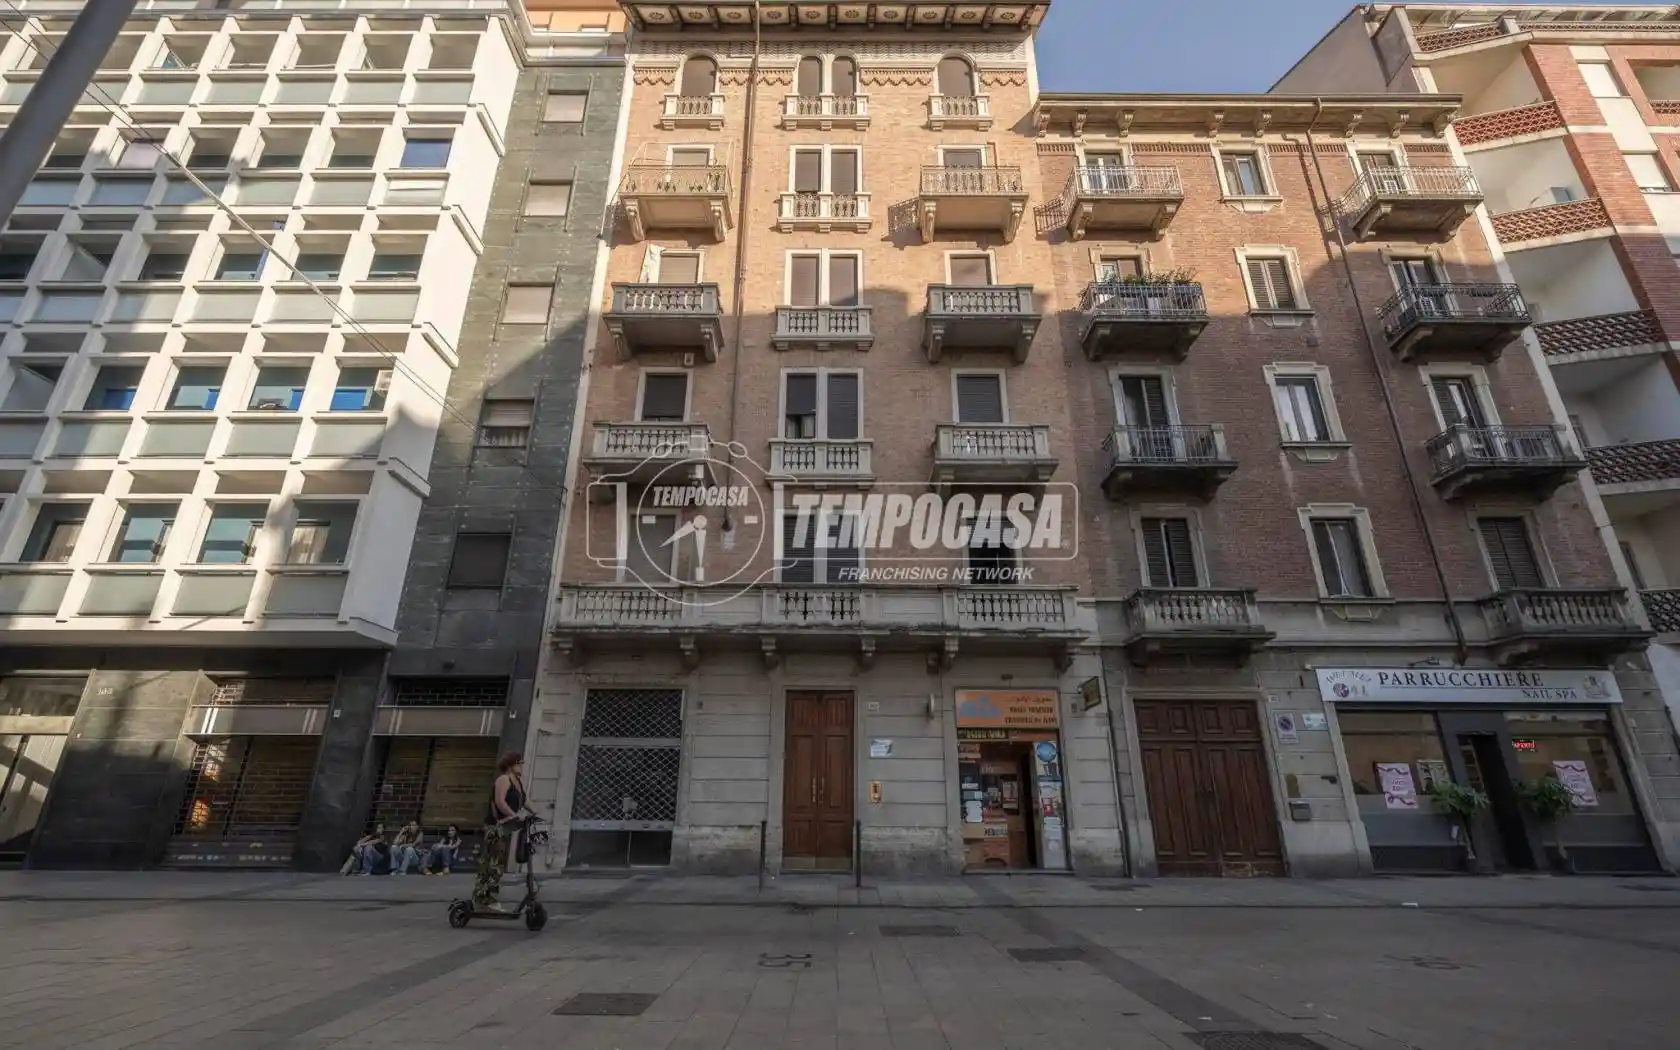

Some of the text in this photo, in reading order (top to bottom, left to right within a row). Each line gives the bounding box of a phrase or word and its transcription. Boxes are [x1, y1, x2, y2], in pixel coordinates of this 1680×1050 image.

[1376, 670, 1544, 688] PARRUCCHIERE
[1521, 688, 1578, 701] NAIL SPA
